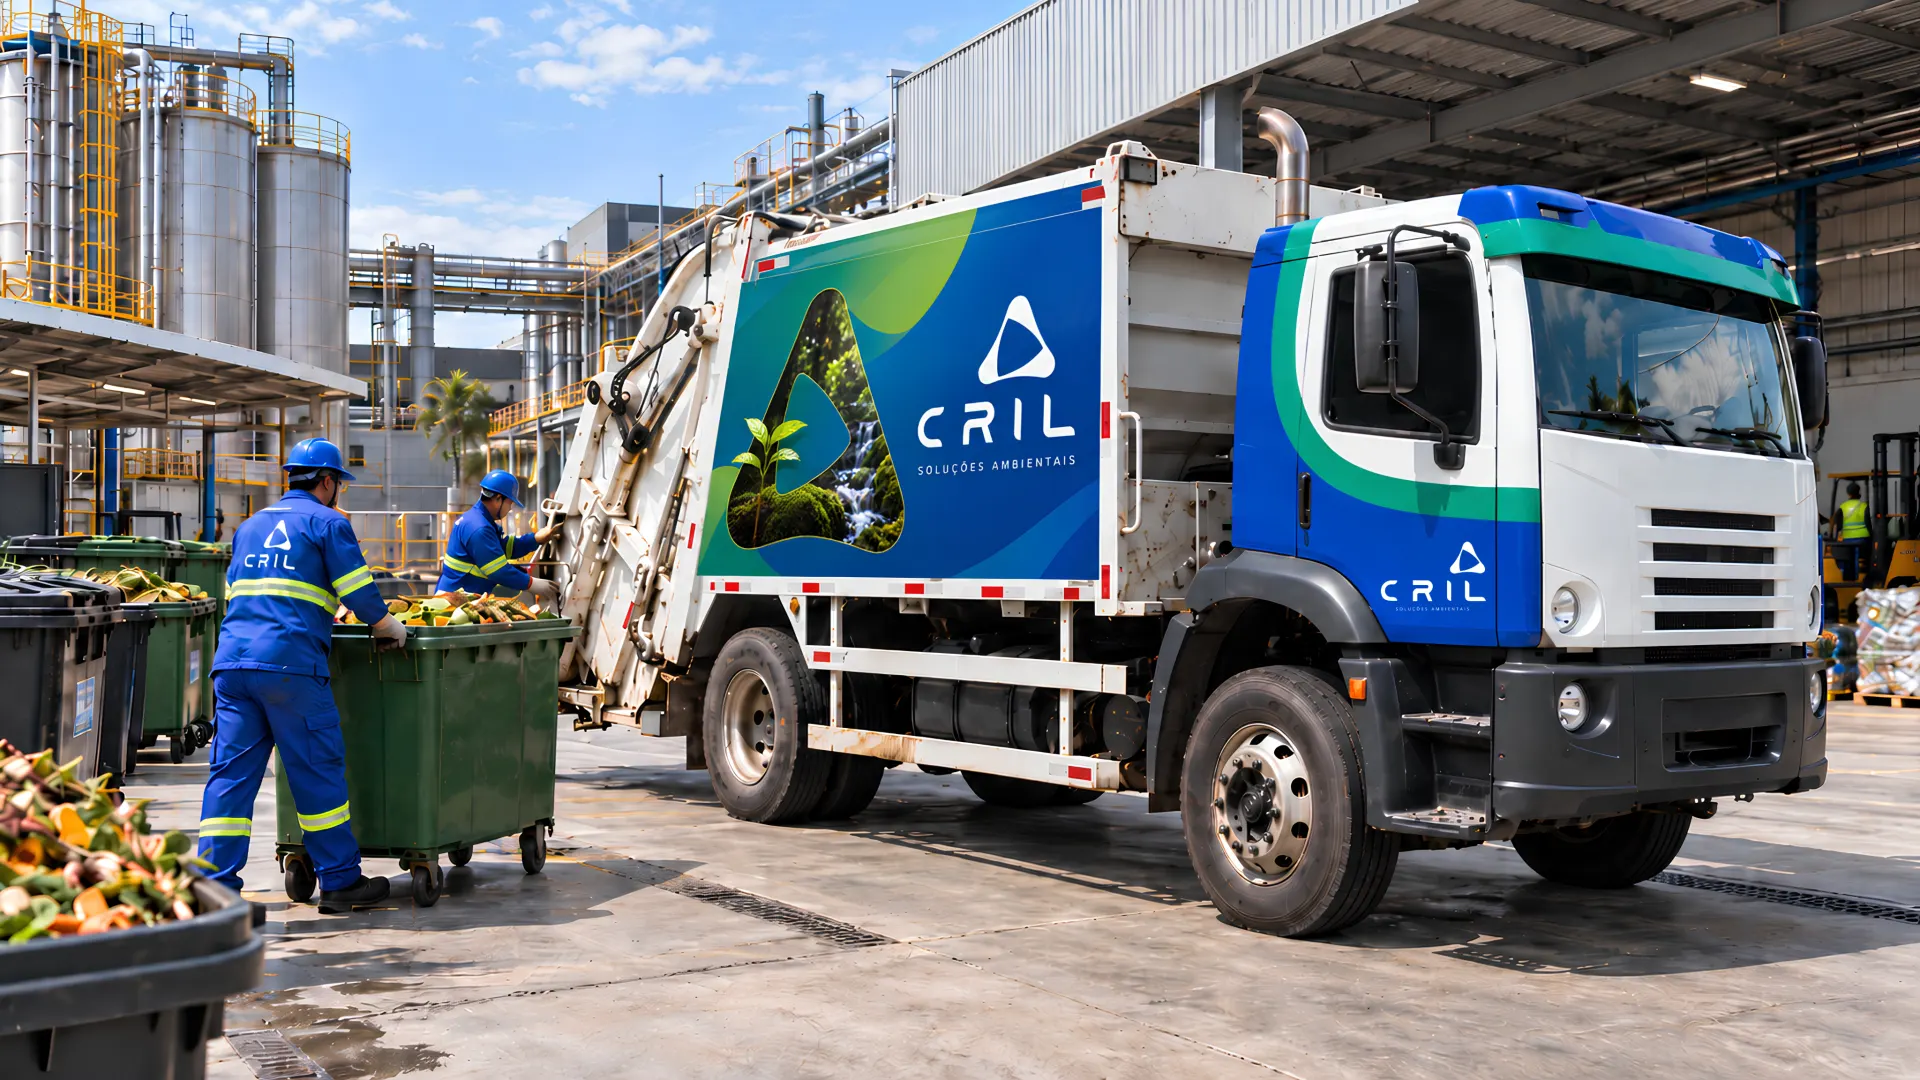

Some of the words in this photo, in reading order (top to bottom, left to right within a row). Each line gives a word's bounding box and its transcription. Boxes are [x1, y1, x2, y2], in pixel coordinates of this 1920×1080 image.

[917, 393, 1076, 448] CRIL
[917, 460, 984, 476] SOLUÇÕES
[991, 454, 1076, 471] AMBIENTAIS
[244, 553, 295, 570] CRIL
[1380, 579, 1487, 602] CRIL
